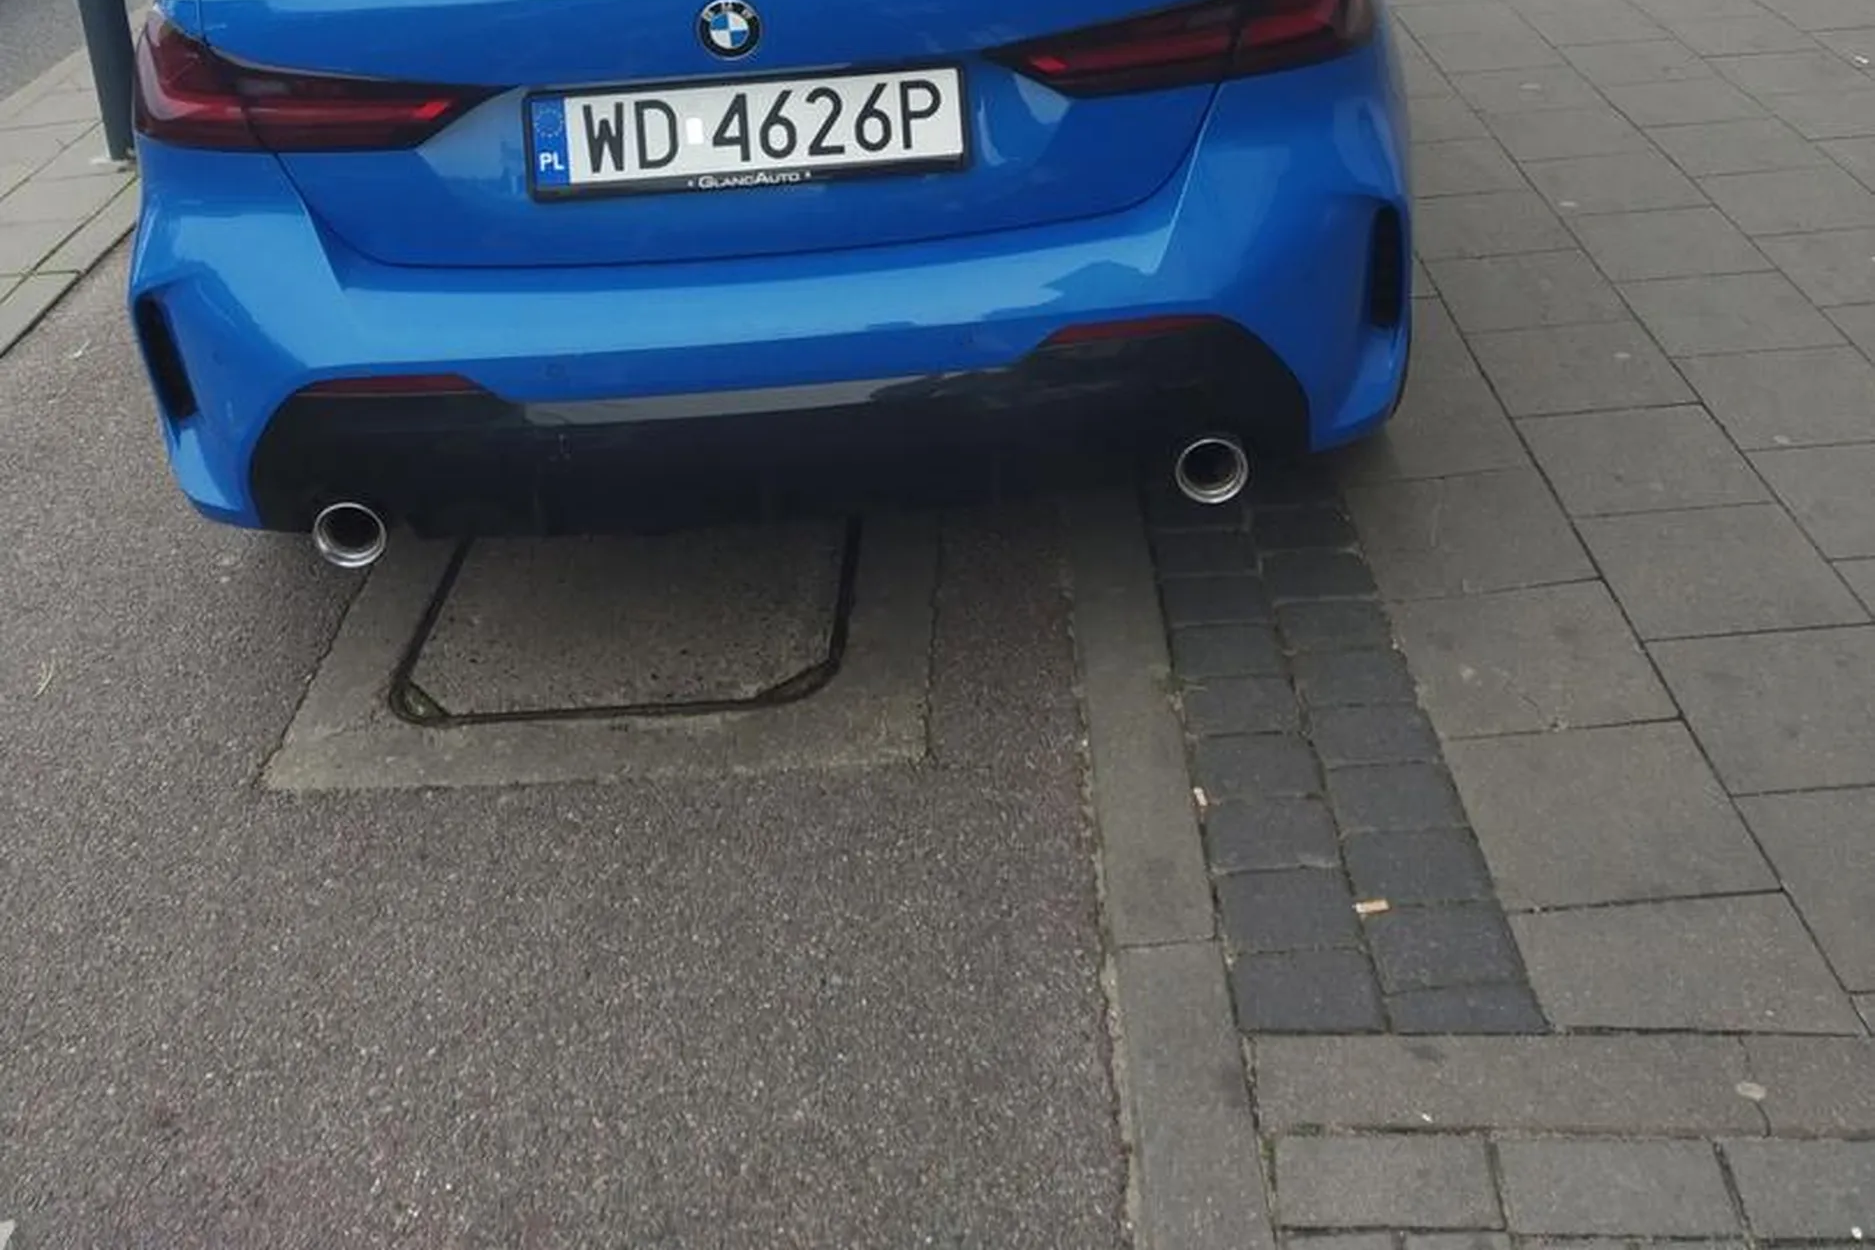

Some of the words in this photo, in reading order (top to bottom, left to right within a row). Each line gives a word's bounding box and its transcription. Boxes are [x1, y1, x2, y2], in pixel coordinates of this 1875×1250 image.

[583, 99, 680, 174] WD
[711, 79, 942, 163] 4626P
[540, 152, 564, 172] PL
